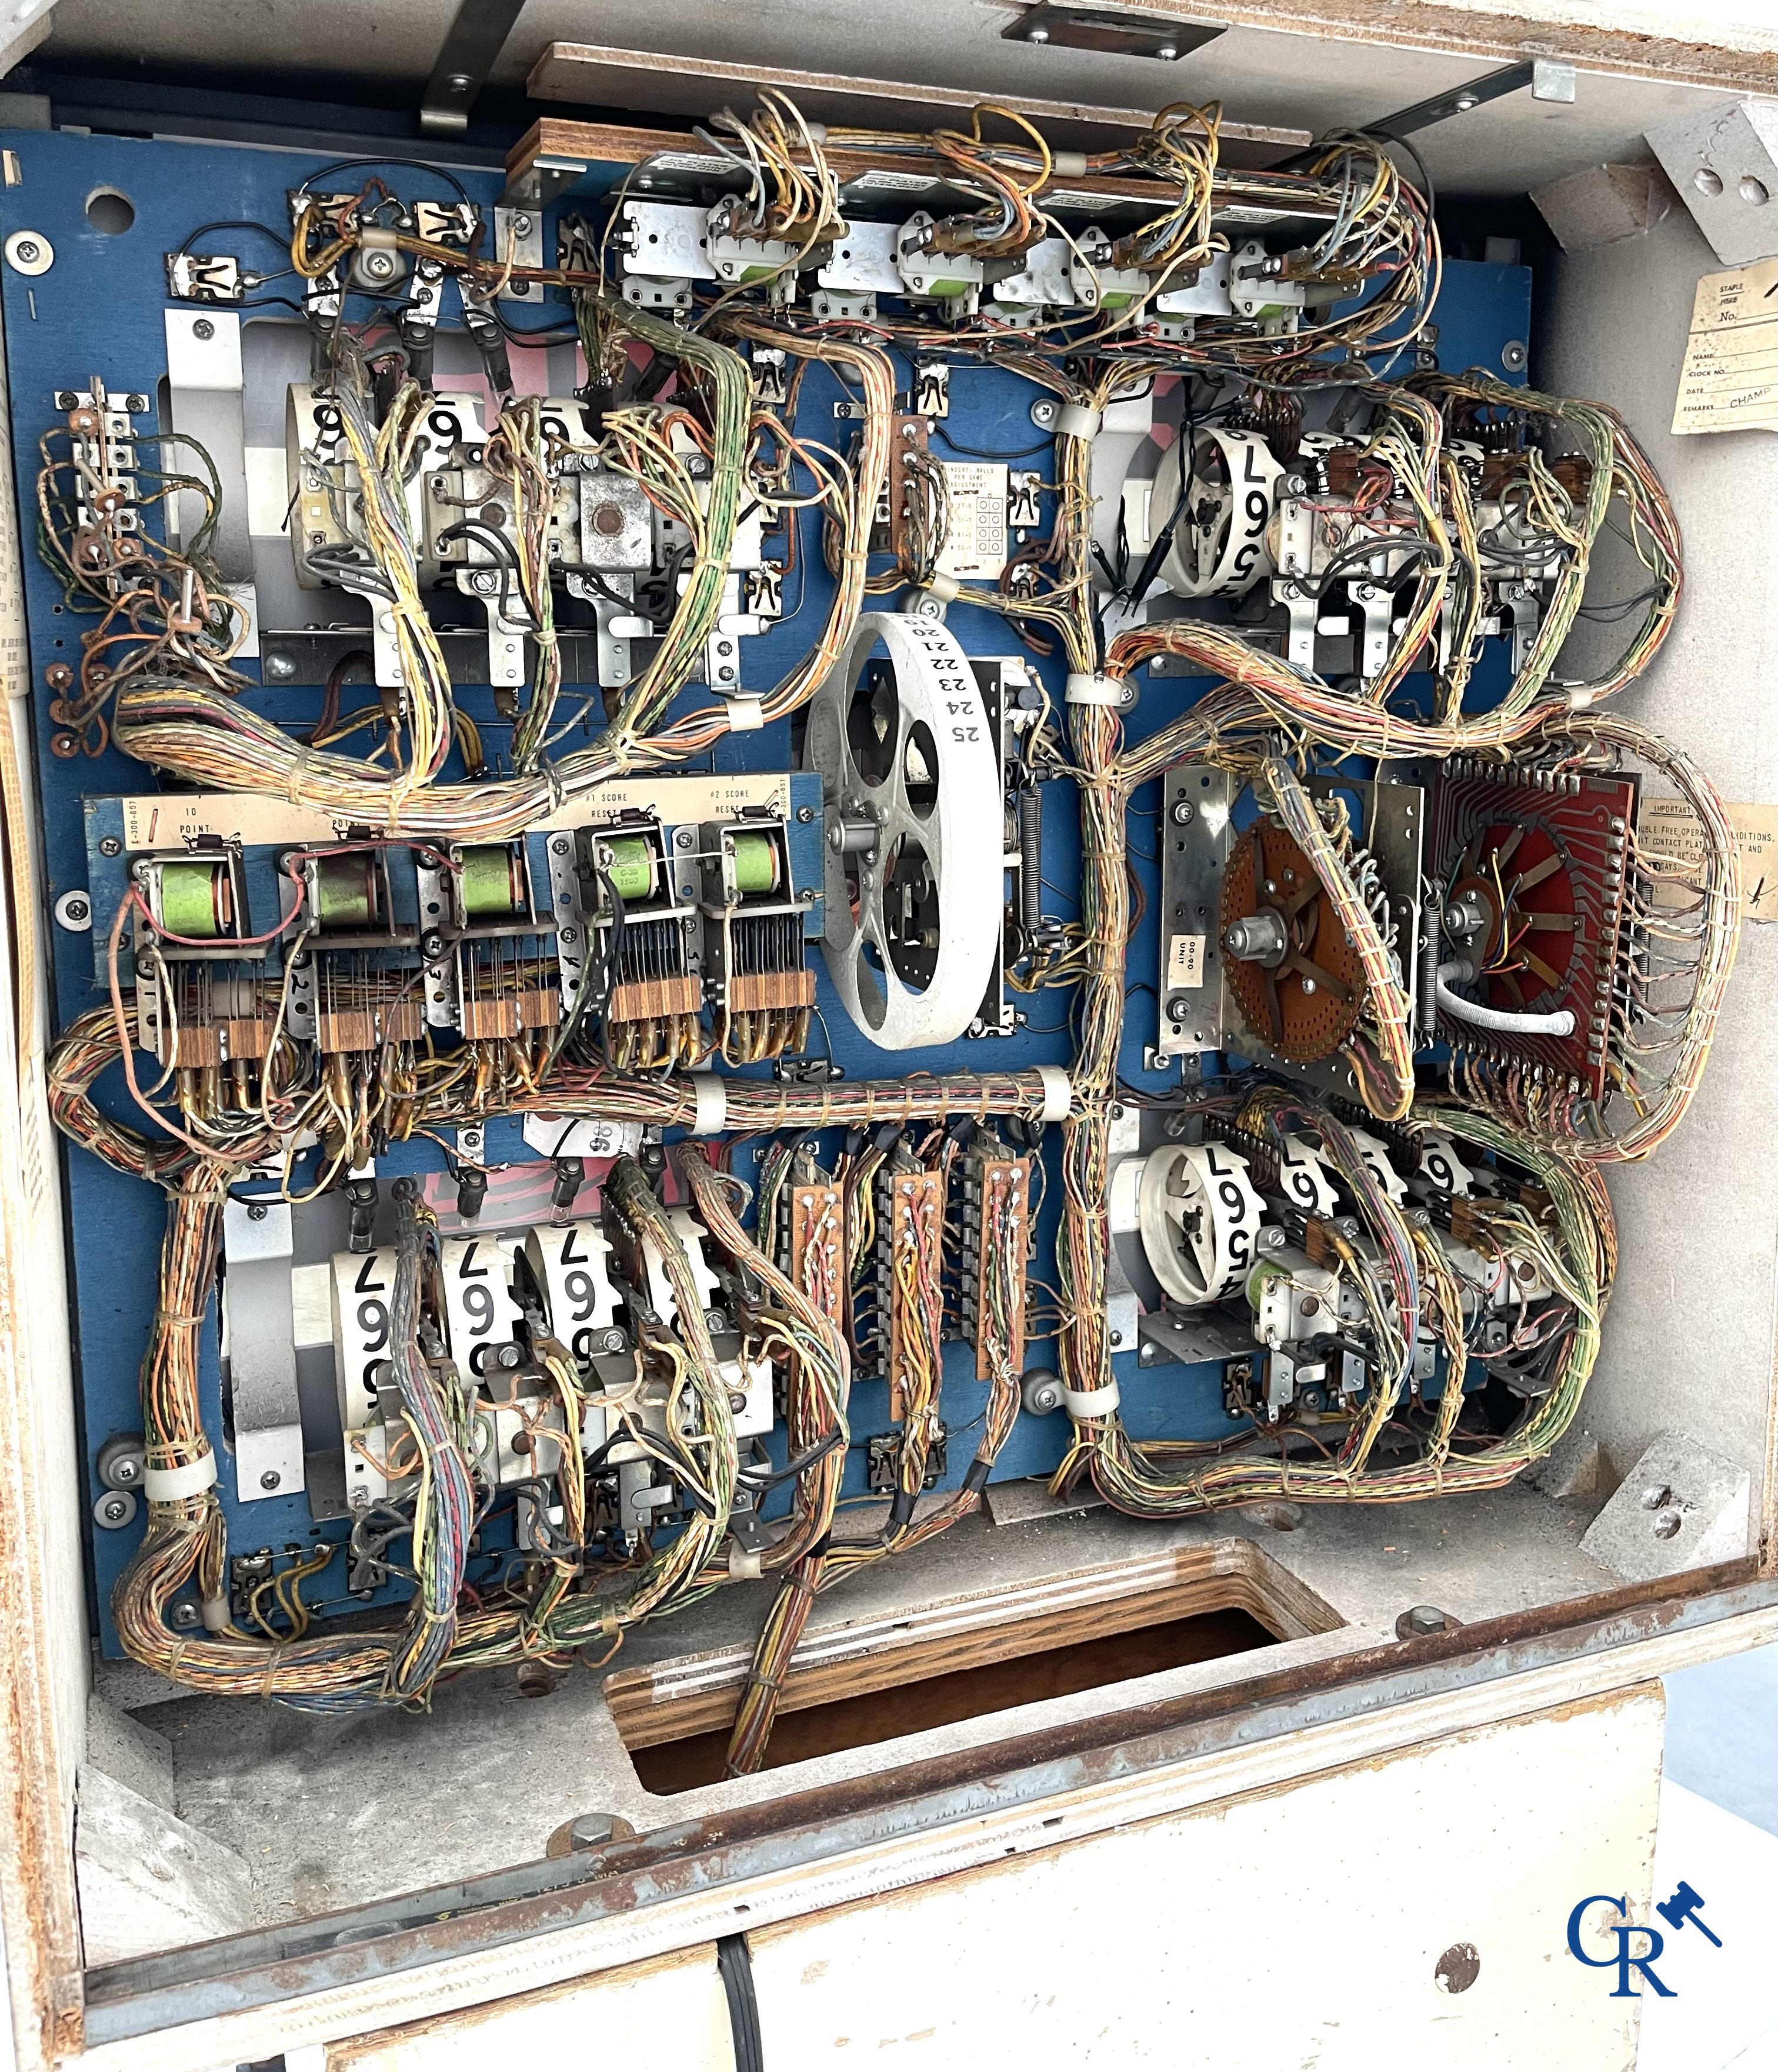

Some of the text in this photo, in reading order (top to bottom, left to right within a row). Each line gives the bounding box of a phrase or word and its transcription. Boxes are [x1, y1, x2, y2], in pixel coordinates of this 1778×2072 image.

[1730, 387, 1771, 408] CHAMP
[921, 642, 949, 651] 21
[930, 659, 959, 669] 22
[939, 679, 967, 691] 23
[946, 701, 974, 715] 24
[952, 727, 979, 742] 25
[602, 793, 628, 802] SCORE
[725, 790, 749, 798] SCORE
[186, 808, 196, 816] 10
[715, 805, 739, 813] RESET
[1654, 805, 1690, 814] IMPORTANT
[180, 824, 210, 834] POINT
[1662, 826, 1678, 835] FREE
[1682, 828, 1703, 837] OPERA
[1653, 838, 1681, 847] CONTACT
[1685, 840, 1703, 848] PLAT
[1748, 845, 1762, 853] AND
